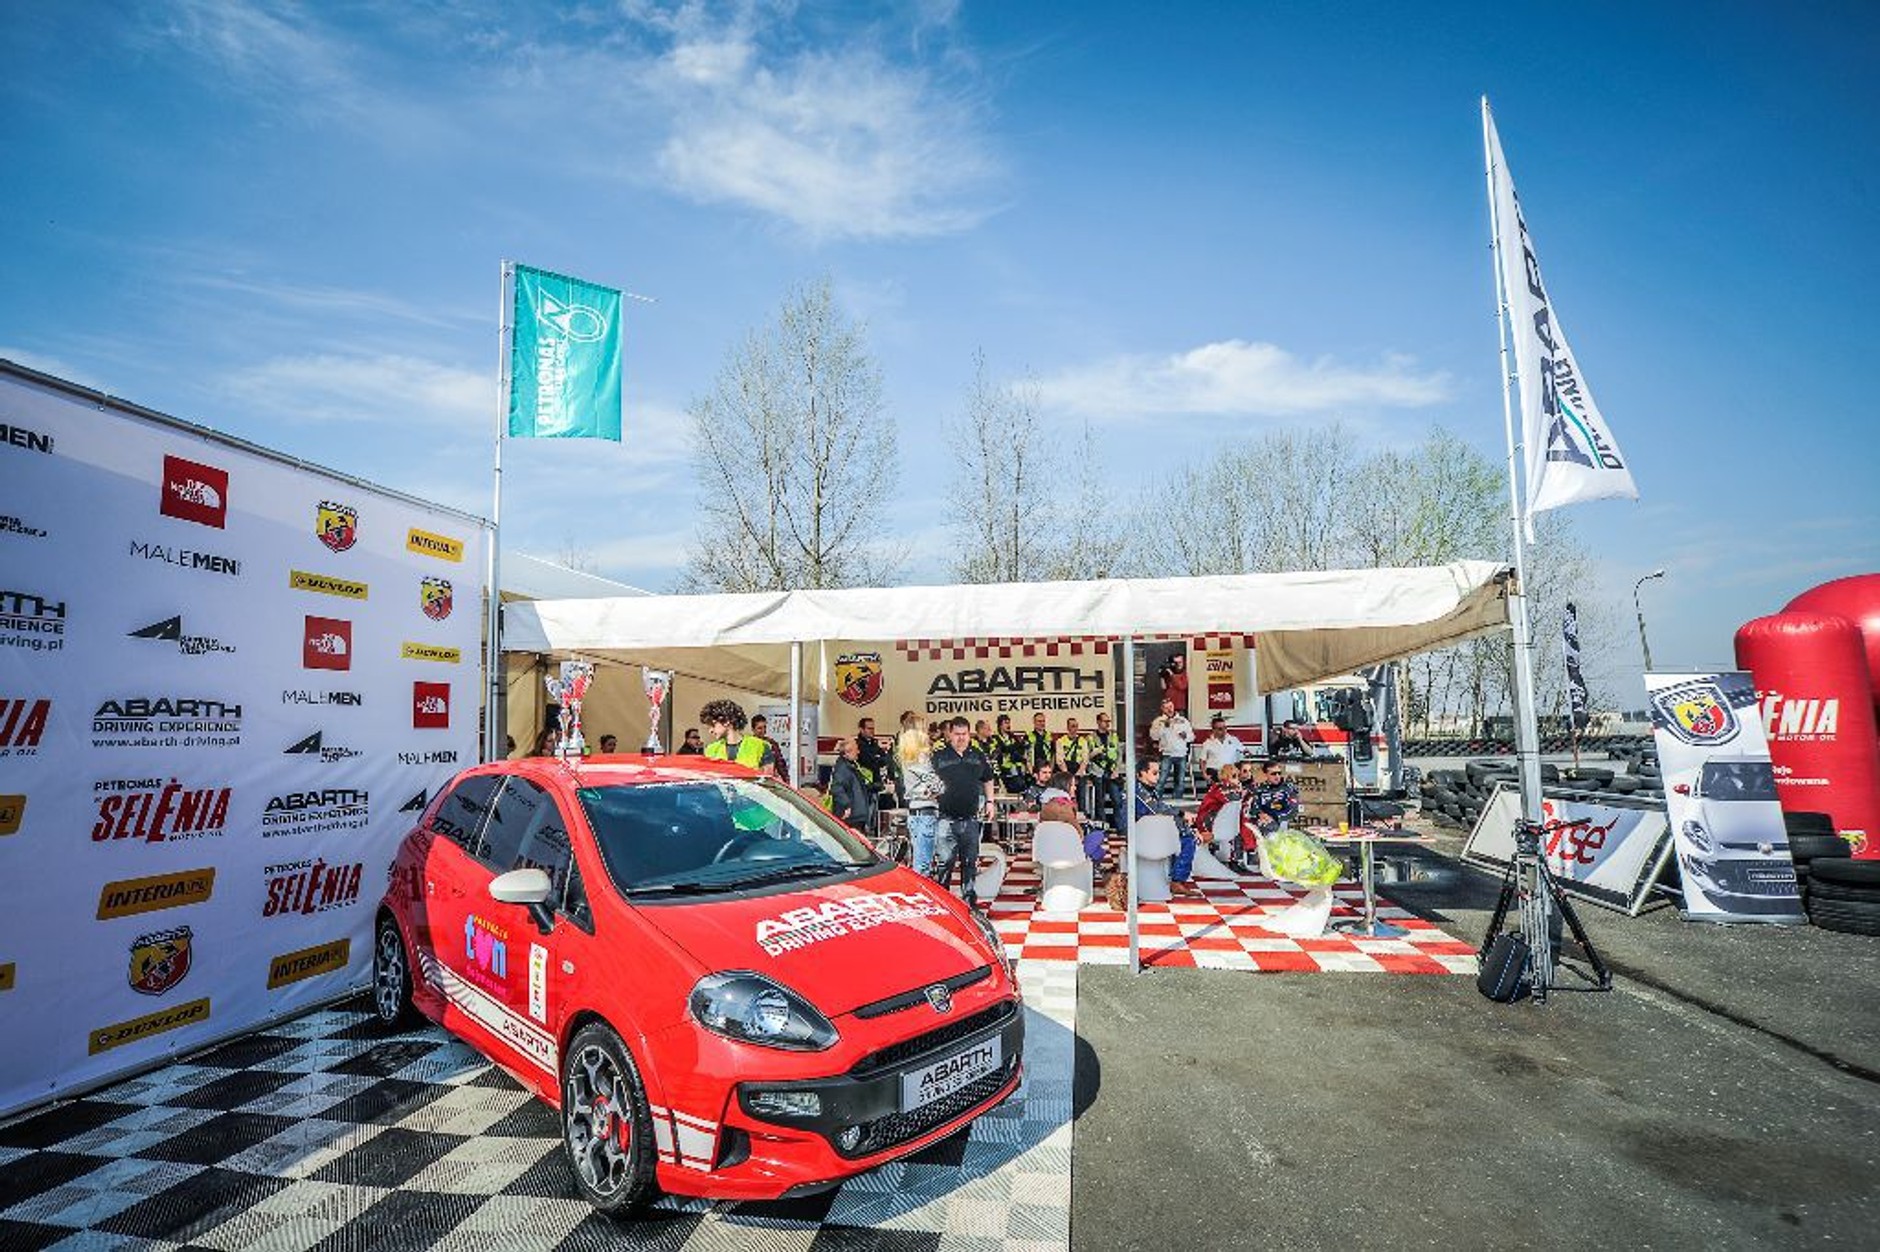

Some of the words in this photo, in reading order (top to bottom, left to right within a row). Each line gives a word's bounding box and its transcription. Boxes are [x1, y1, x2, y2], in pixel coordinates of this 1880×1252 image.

[130, 540, 236, 576] MALEMEN
[927, 666, 1105, 695] ABARTH
[94, 697, 242, 718] ABARTH
[926, 699, 993, 714] DRIVING
[998, 695, 1105, 713] EXPERIENCE
[92, 721, 154, 733] DRIVING
[159, 721, 241, 733] EXPERIENCE
[94, 779, 163, 791] PETRONAS
[264, 789, 369, 812] ABARTH
[756, 892, 934, 943] ABARTH
[920, 1046, 993, 1088] ABARTH
